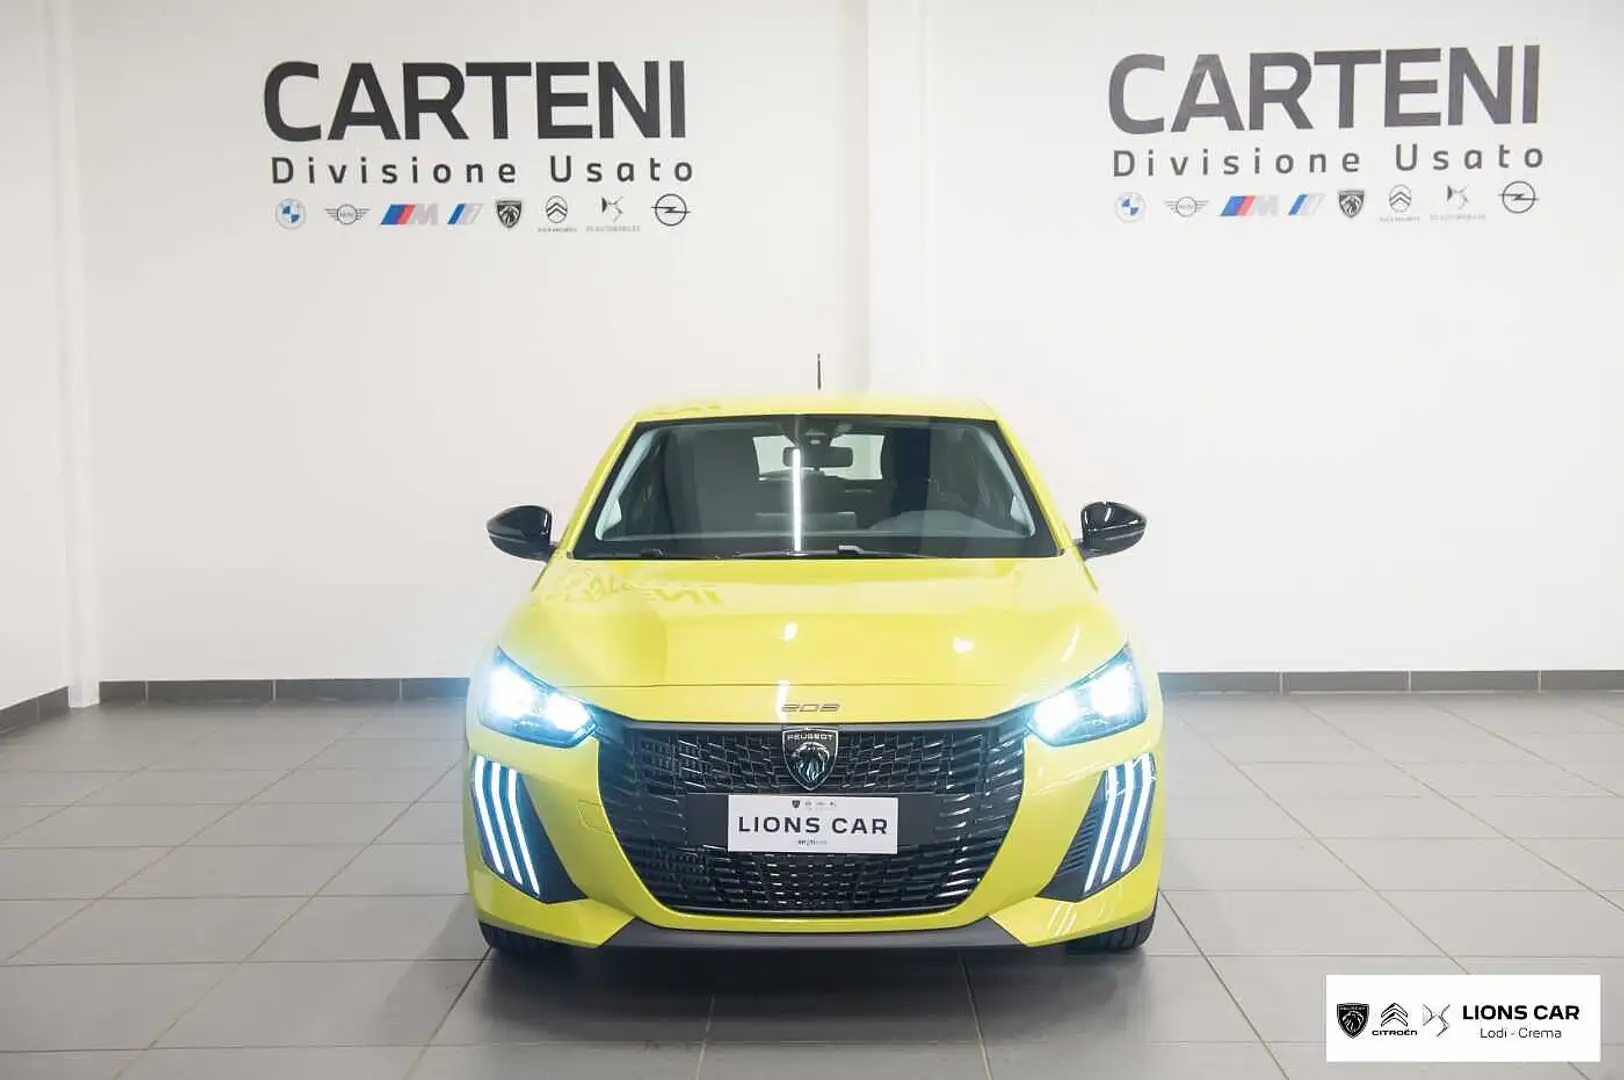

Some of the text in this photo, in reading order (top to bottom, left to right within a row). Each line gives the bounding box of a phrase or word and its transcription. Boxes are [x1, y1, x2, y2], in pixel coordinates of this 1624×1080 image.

[263, 60, 687, 142] CARTENI
[1109, 44, 1541, 135] CARTENI
[271, 155, 694, 184] Divisione Usato
[1113, 144, 1544, 177] Divisione Usato
[738, 816, 889, 834] LIONS CAR
